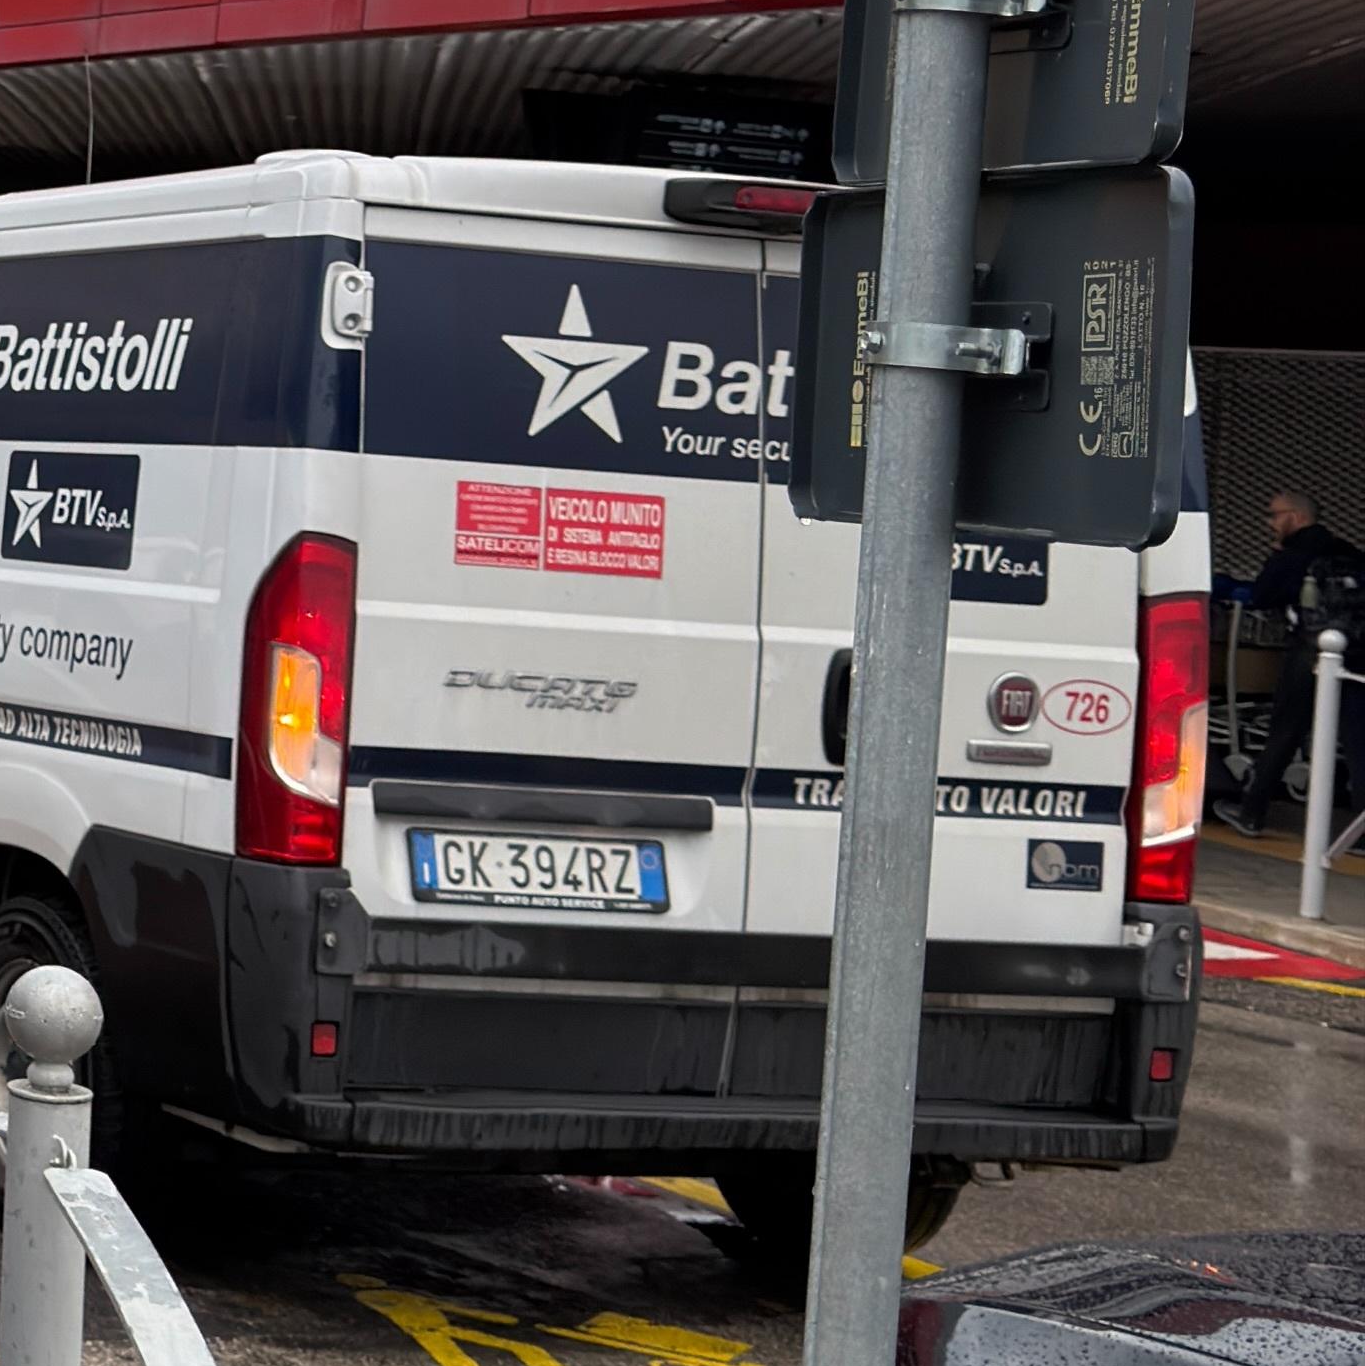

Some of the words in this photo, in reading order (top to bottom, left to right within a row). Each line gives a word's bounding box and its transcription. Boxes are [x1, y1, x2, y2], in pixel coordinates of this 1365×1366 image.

[1085, 283, 1107, 341] PSR
[657, 341, 795, 417] Bat
[662, 426, 726, 457] Your
[1078, 401, 1103, 457] CE
[52, 488, 103, 526] BTV
[549, 496, 608, 524] VEICOLO
[610, 501, 662, 527] MUNITO
[951, 543, 1004, 573] BTV
[20, 625, 133, 680] company
[444, 671, 638, 698] DUCATO
[1001, 689, 1032, 718] FIAT
[1066, 691, 1110, 724] 726
[17, 710, 50, 741] ALTA
[53, 717, 144, 757] TECNOLOGIA
[980, 787, 1087, 818] VALORI
[444, 840, 493, 887] GK
[507, 843, 635, 894] 394RZ
[494, 895, 530, 906] PUNTO
[531, 897, 560, 908] AUTO
